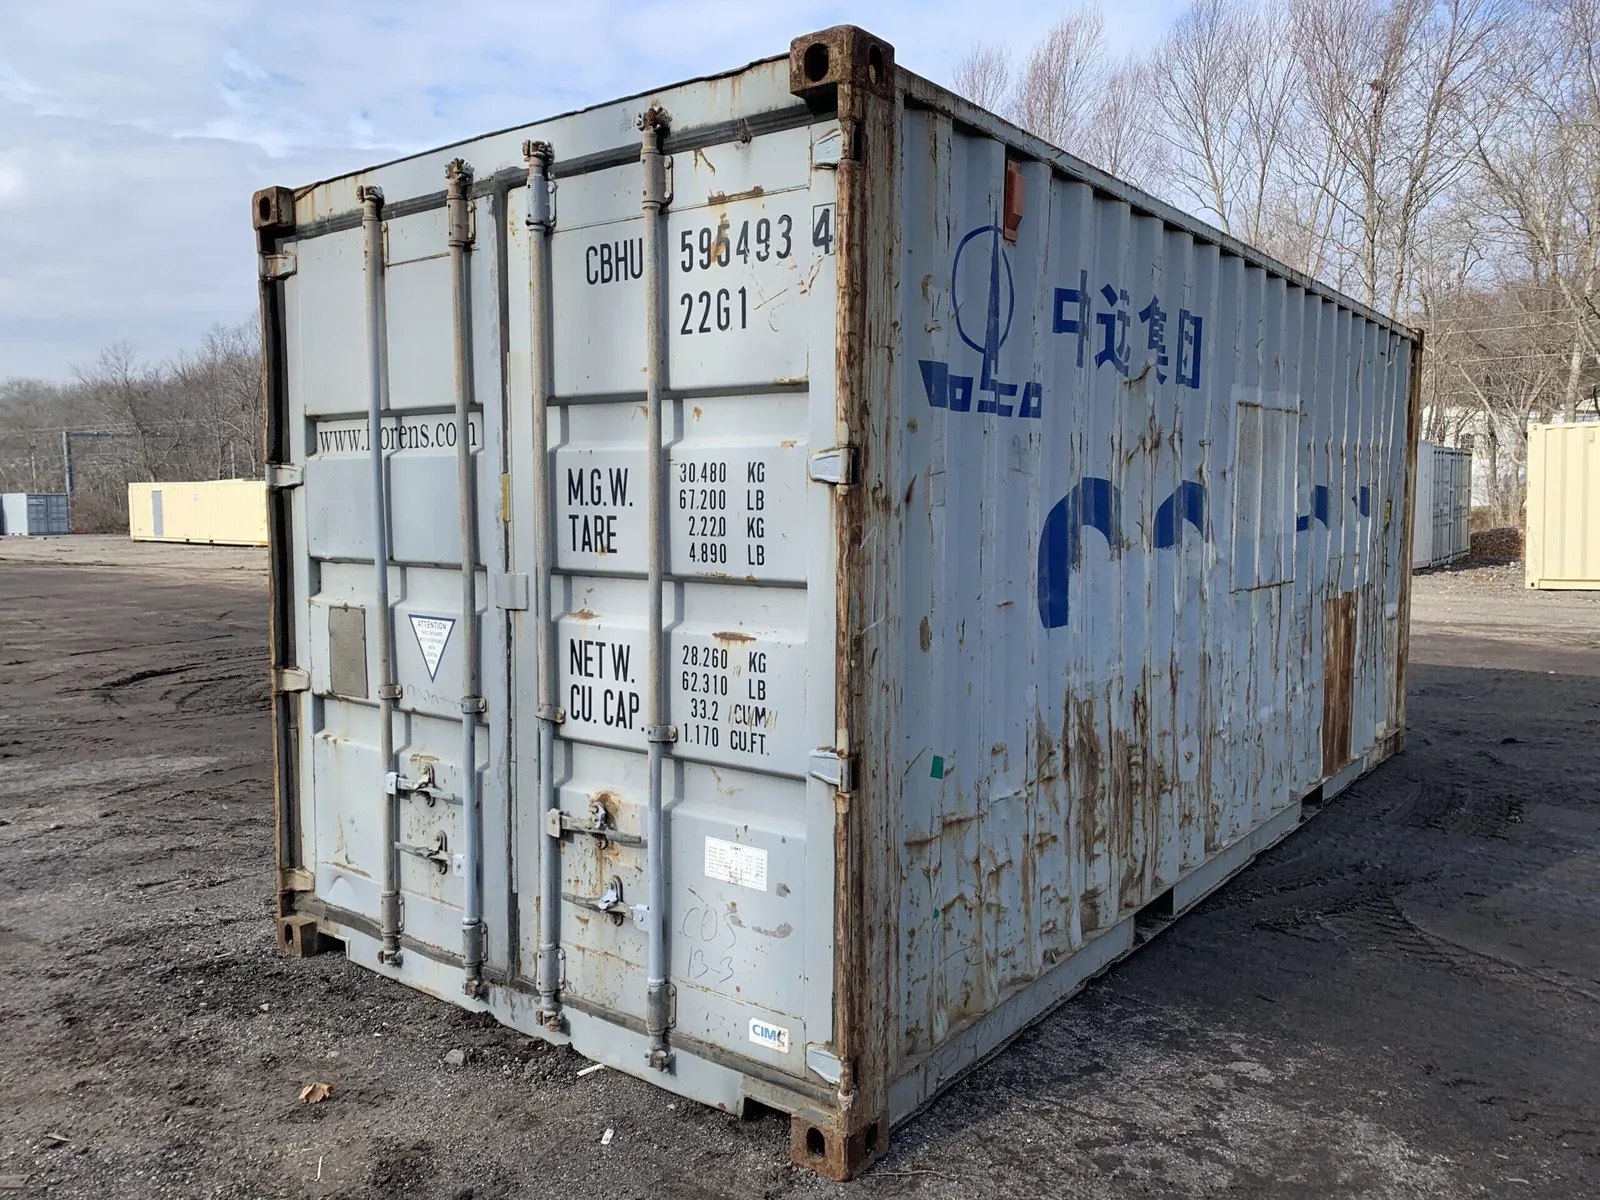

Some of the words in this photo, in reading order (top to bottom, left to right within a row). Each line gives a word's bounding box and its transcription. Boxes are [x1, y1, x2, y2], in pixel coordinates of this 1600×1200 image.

[585, 237, 644, 285] CBHU
[680, 214, 793, 273] 595493
[813, 208, 833, 255] 4
[680, 285, 747, 335] 22G1
[747, 462, 765, 483] KG
[567, 468, 634, 507] M.G.W.
[747, 489, 765, 511] LB
[568, 514, 618, 554] TARE
[747, 516, 765, 538] KG
[747, 544, 765, 566] LB
[418, 620, 447, 631] ATTENTION
[748, 651, 766, 674] KG
[748, 679, 766, 701] LB
[570, 683, 597, 724] CU.
[604, 689, 645, 732] CAP.
[690, 698, 719, 721] 33.2
[752, 1024, 787, 1045] CIMC
